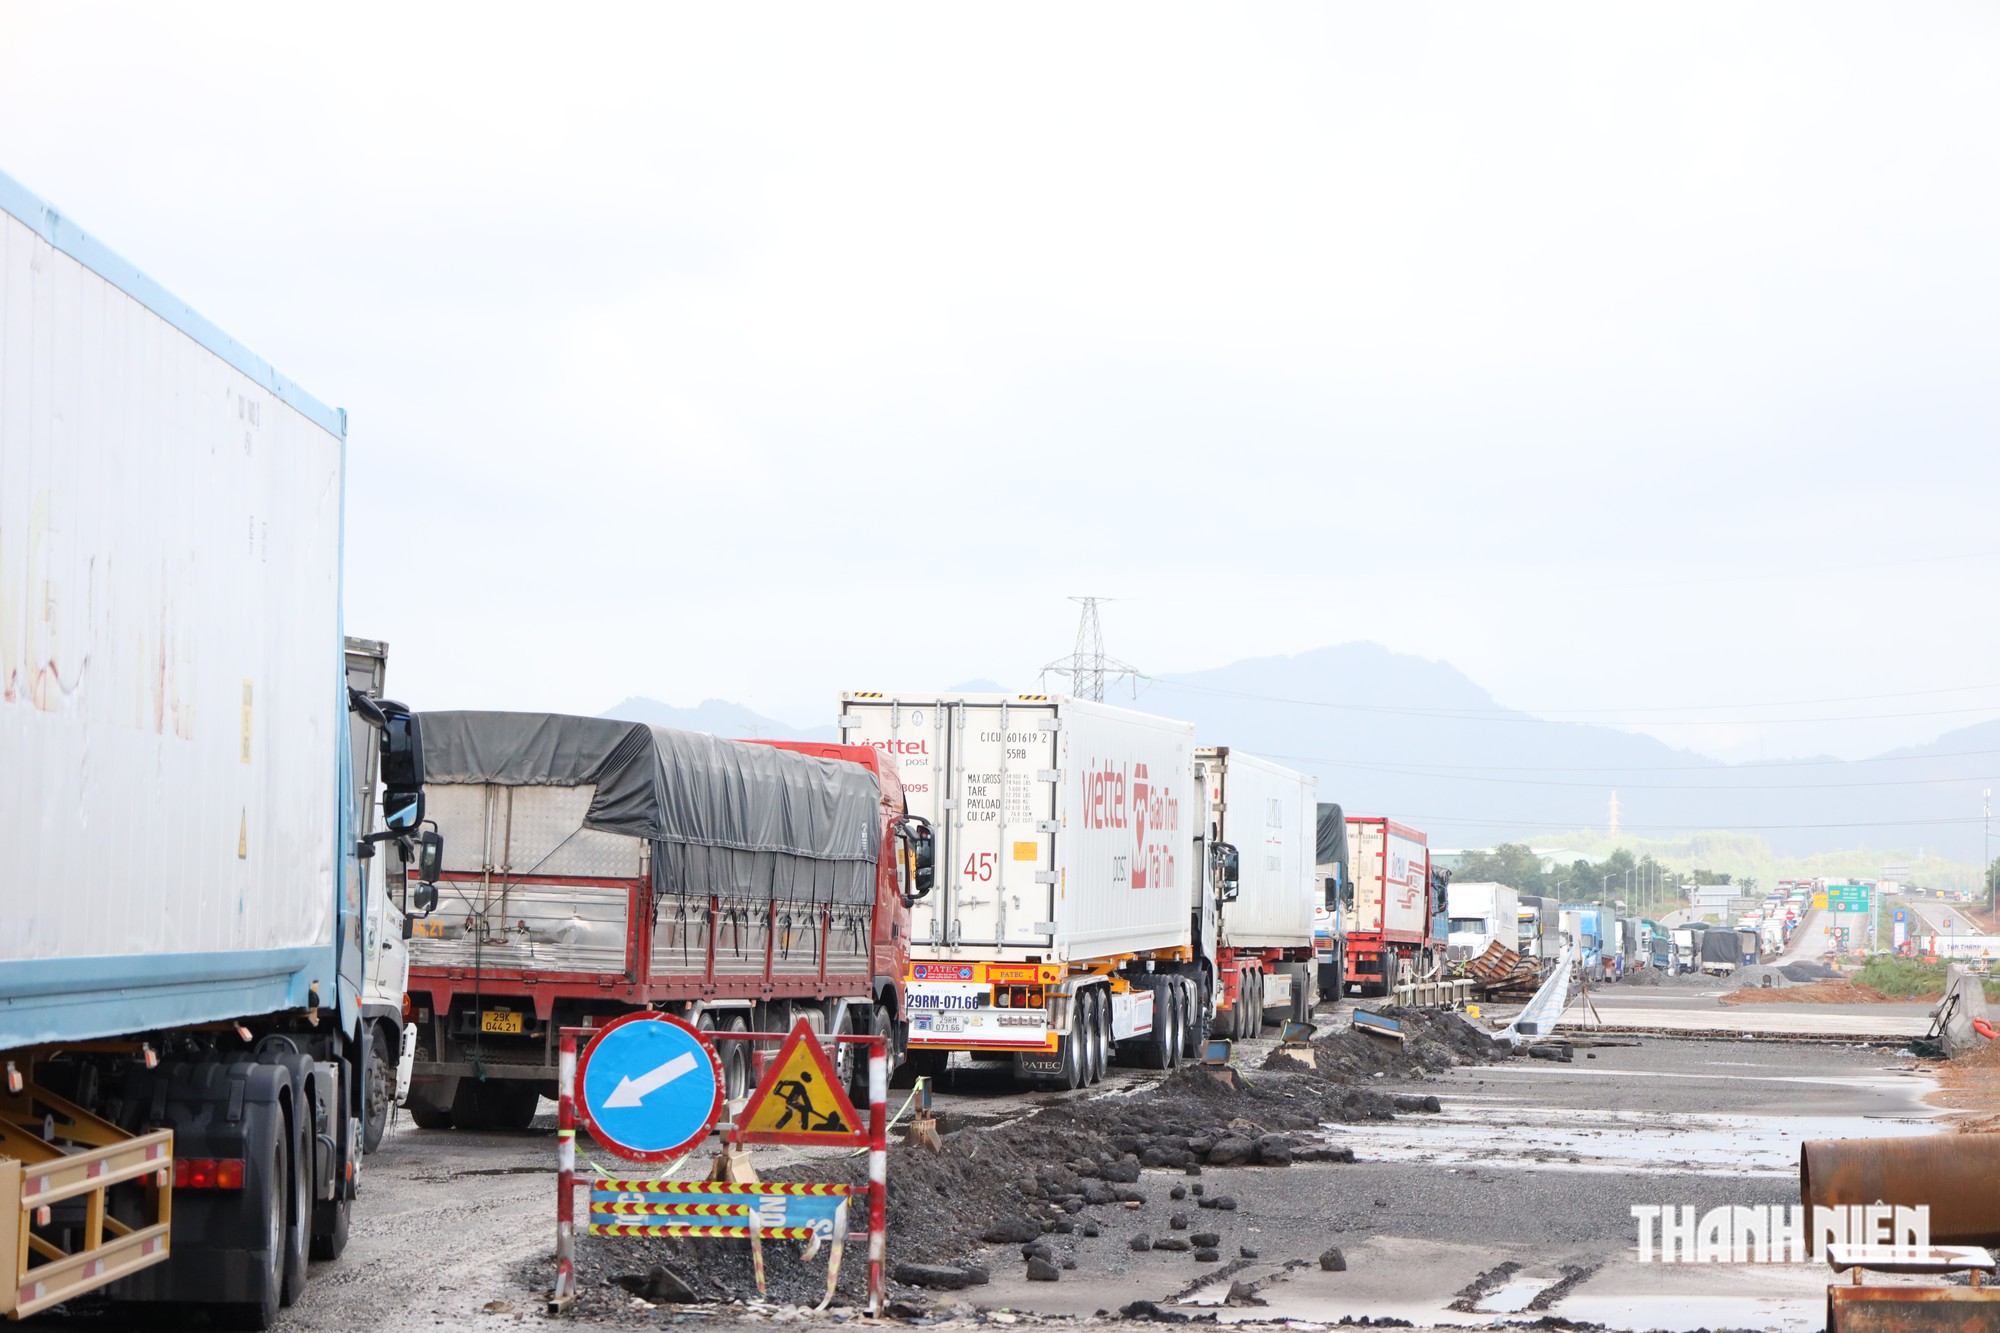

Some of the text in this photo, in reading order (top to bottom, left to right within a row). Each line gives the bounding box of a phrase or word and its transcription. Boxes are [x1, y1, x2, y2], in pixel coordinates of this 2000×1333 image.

[981, 732, 1047, 743] CICU 601619 2
[1006, 748, 1027, 759] 55RB
[905, 758, 929, 766] post
[967, 773, 981, 784] MAX
[982, 773, 1001, 784] GROSS
[968, 786, 987, 796] TARE
[1082, 757, 1128, 830] viettel
[967, 798, 1001, 809] PAYLOAD
[1149, 784, 1164, 831] Giao
[964, 852, 998, 882] 45'
[1148, 843, 1162, 889] Trái
[1112, 855, 1127, 890] post
[927, 965, 958, 973] PATEC
[908, 994, 979, 1010] 29RM-071.66
[493, 1012, 510, 1022] 29K
[485, 1022, 516, 1032] 044.21
